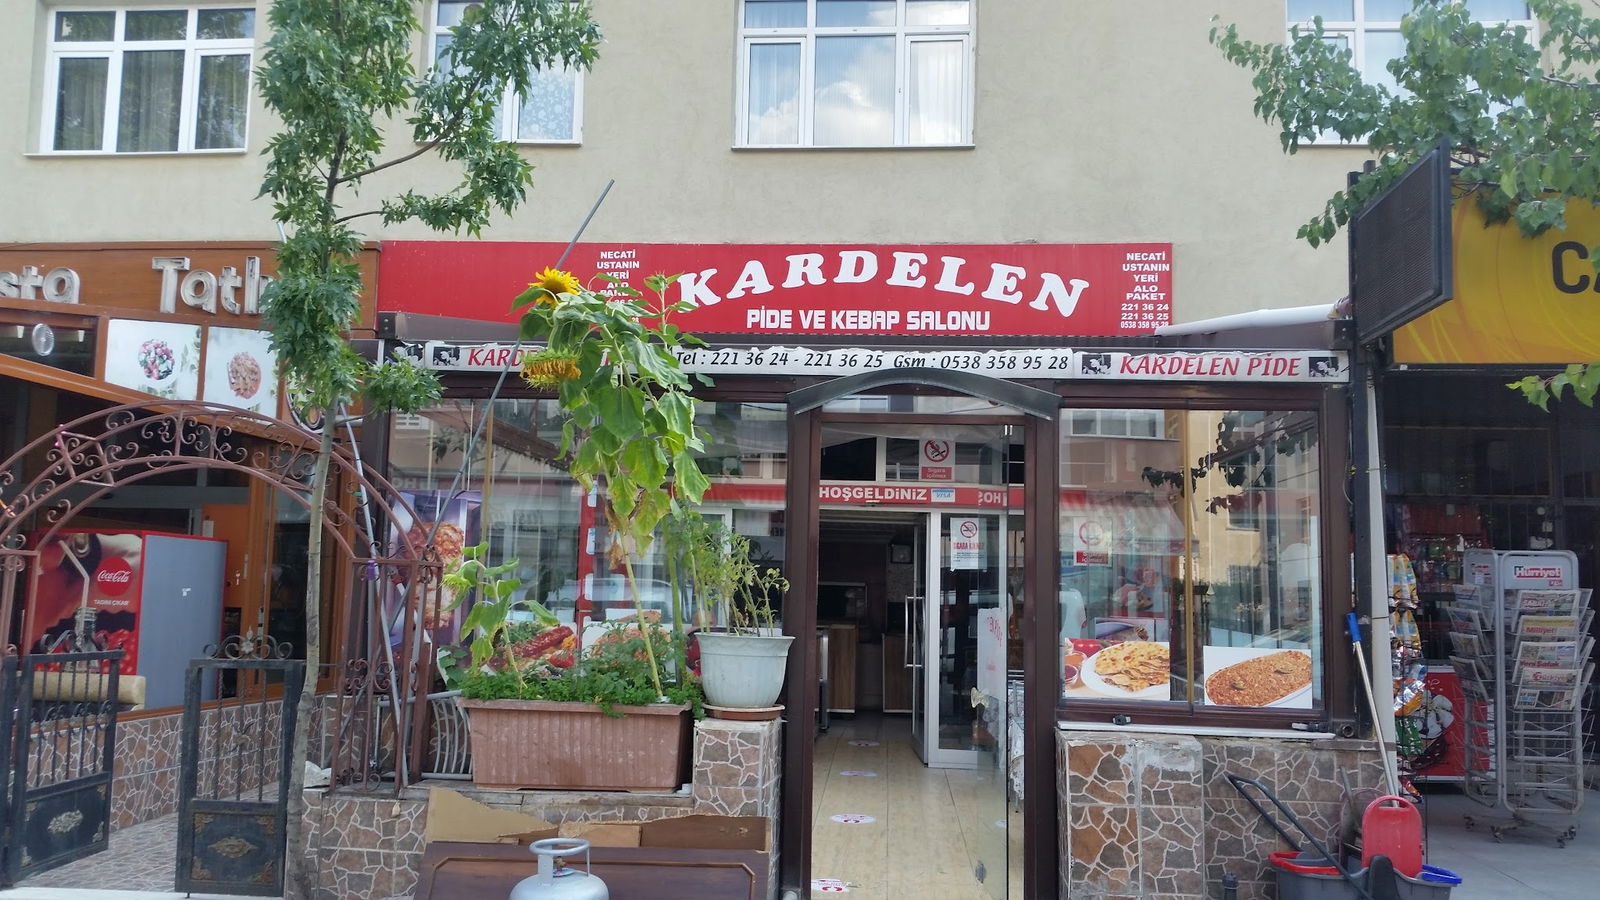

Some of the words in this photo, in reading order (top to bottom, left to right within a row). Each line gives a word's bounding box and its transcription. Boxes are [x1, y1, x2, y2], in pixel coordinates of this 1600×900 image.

[600, 249, 636, 259] NECATİ
[1126, 251, 1166, 261] NECATİ
[597, 261, 640, 269] USTANIN
[1122, 263, 1170, 272] USTANIN
[1552, 241, 1600, 294] C
[1133, 273, 1159, 283] YERİ
[676, 250, 1089, 317] KARDELEN
[1133, 285, 1158, 293] ALO
[1126, 293, 1166, 301] PAKET
[747, 305, 792, 329] PİDE
[799, 310, 825, 329] VE
[831, 310, 900, 330] KEBAP
[906, 311, 990, 331] SALONU
[1120, 321, 1136, 329] 0538
[1137, 321, 1150, 329] 358
[467, 348, 538, 367] KARD
[677, 351, 697, 366] Tel
[710, 352, 739, 366] 221
[744, 352, 763, 366] 36
[769, 352, 789, 367] 24
[805, 353, 833, 368] 221
[838, 353, 858, 368] 36
[865, 354, 883, 368] 25
[893, 355, 926, 370] Gsm
[940, 355, 981, 370] 0538
[987, 355, 1017, 370] 358
[1022, 355, 1043, 370] 95
[1048, 355, 1069, 370] 28
[1119, 356, 1240, 376] KARDELEN
[1247, 354, 1301, 377] PİDE
[1514, 566, 1561, 578] Hürriyet
